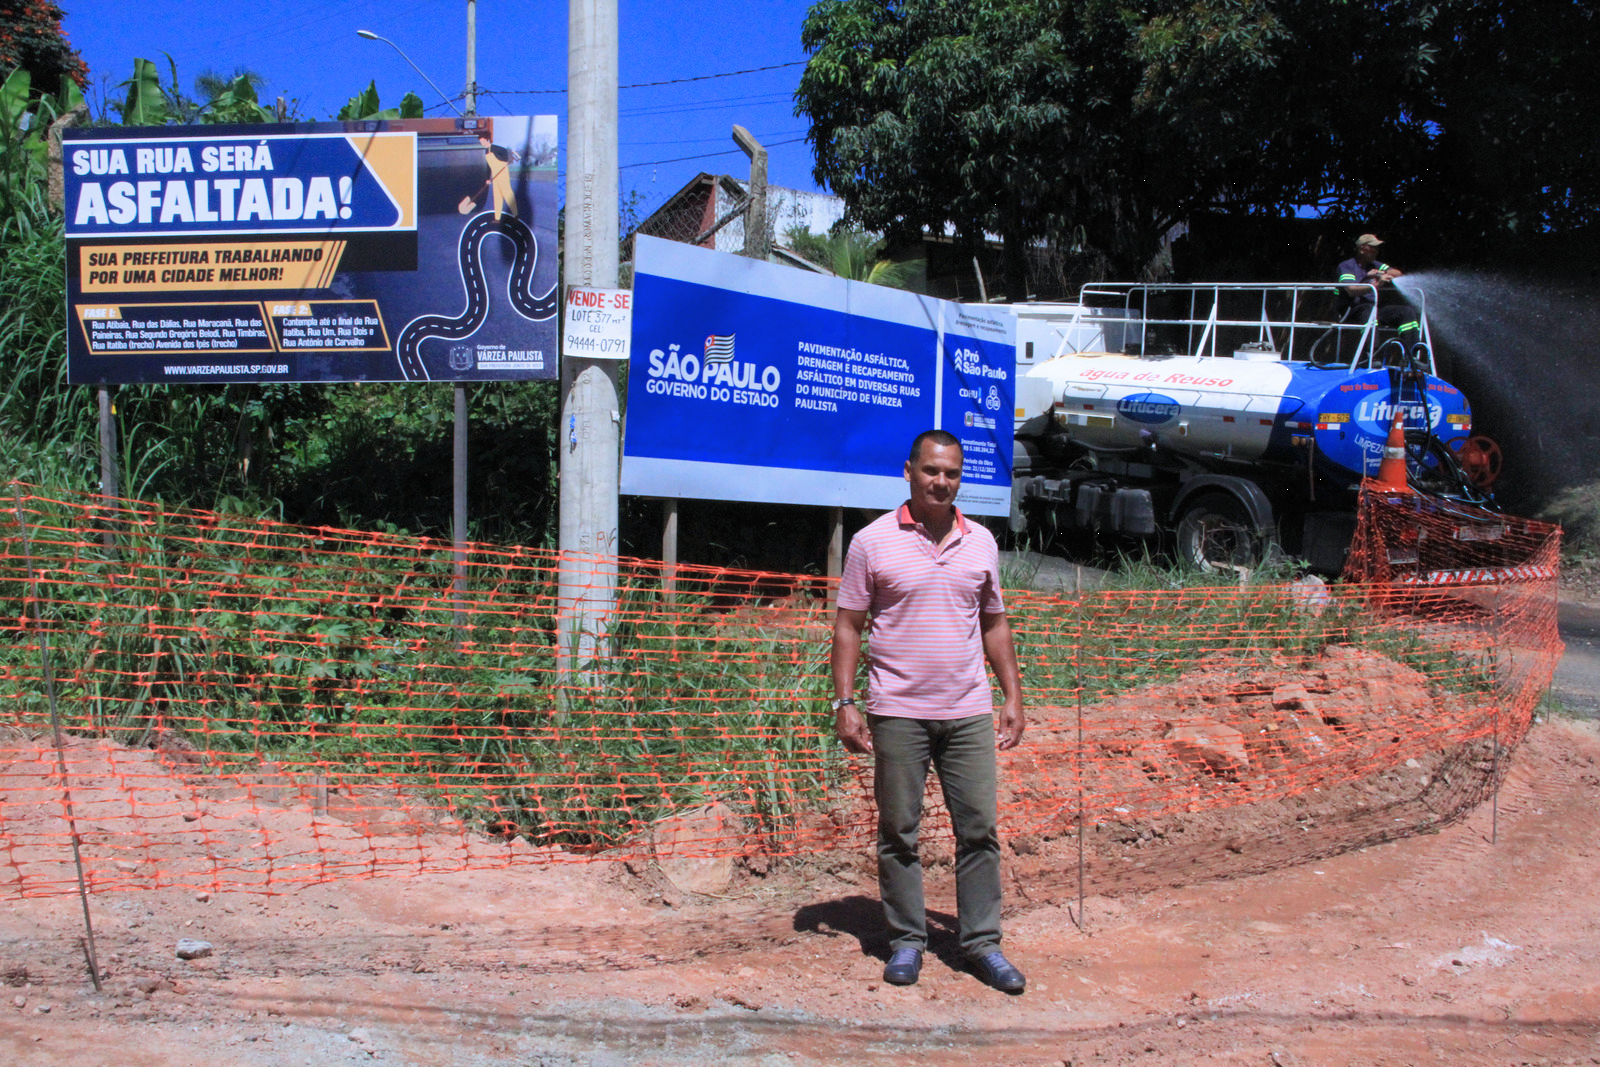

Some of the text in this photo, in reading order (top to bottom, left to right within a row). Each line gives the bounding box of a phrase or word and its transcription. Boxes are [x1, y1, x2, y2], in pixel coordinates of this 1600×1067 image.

[72, 140, 274, 175] SUA RUA SERÁ
[74, 175, 353, 225] ASFALTADA!
[89, 248, 323, 267] SUA PREFEITURA TRABALHANDO
[89, 266, 284, 284] POR UMA CIDADE MELHOR!
[569, 290, 630, 309] VENDE-SE
[84, 308, 107, 318] FASE
[273, 305, 308, 315] FASE 2:
[571, 309, 592, 323] LOTE
[594, 312, 612, 323] 377
[92, 320, 105, 330] Rua
[106, 320, 131, 330] Atibaia,
[132, 320, 146, 329] Rua
[146, 319, 159, 329] das
[183, 319, 197, 328] Rua
[198, 318, 234, 328] Maracanã,
[235, 318, 249, 327] Rua
[250, 318, 262, 327] das
[282, 316, 378, 327] Contempla até o final da Rua
[125, 330, 139, 339] Rua
[140, 330, 168, 340] Segundo
[169, 329, 198, 339] Gregório
[222, 329, 236, 338] Rua
[307, 327, 321, 337] Rua
[322, 327, 336, 337] Um,
[338, 327, 351, 336] Rua
[353, 327, 367, 336] Dois
[92, 341, 106, 350] Rua
[128, 340, 155, 350] (trecho)
[156, 340, 181, 349] Avenida
[183, 340, 195, 349] dos
[211, 338, 238, 348] (trecho)
[282, 338, 296, 347] Rua
[325, 337, 333, 347] de
[335, 337, 365, 346] Carvalho
[567, 335, 626, 353] 94444-0791
[477, 350, 543, 361] VÁRZEA PAULISTA
[798, 341, 910, 371] PAVIMENTAÇÃO ASFÁLTICA,
[963, 348, 980, 363] Pró
[164, 364, 289, 375] WWW.VARZEAPAULISTA.SP.GOV.BR
[647, 343, 781, 393] SÃO PAULO
[797, 355, 915, 383] DRENAGEM E RECAPEAMENTO
[962, 361, 1007, 380] São Paulo
[796, 369, 921, 397] ASFÁLTICO EM DIVERSAS RUAS
[1080, 368, 1234, 387] água de Reuso
[646, 379, 779, 408] GOVERNO DO ESTADO
[796, 384, 903, 408] DO MUNICÍPIO DE VÁRZEA
[795, 398, 838, 412] PAULISTA
[1119, 399, 1180, 416] Litucera
[1354, 434, 1385, 454] LIMPEZA
